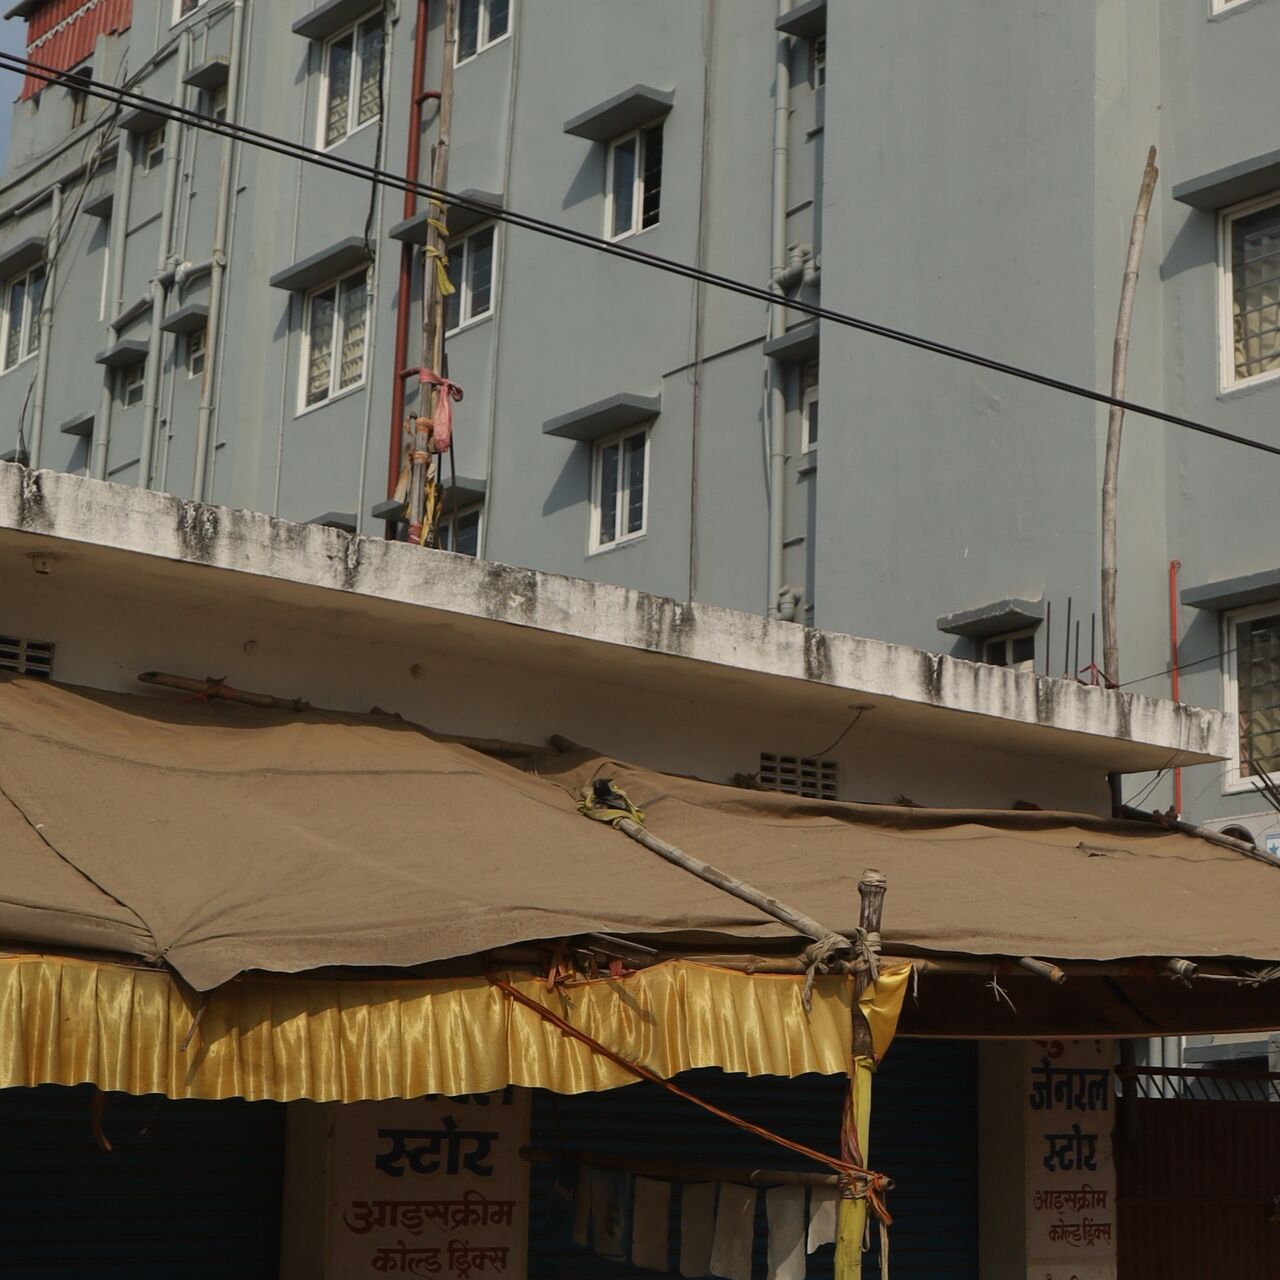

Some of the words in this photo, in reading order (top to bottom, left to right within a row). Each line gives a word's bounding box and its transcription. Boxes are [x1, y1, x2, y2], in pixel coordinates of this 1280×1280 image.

[375, 1115, 498, 1178] स्टोर
[1043, 1124, 1098, 1172] स्टोर
[343, 1190, 516, 1235] आइसक्रीम
[1048, 1218, 1081, 1247] कोल्ड
